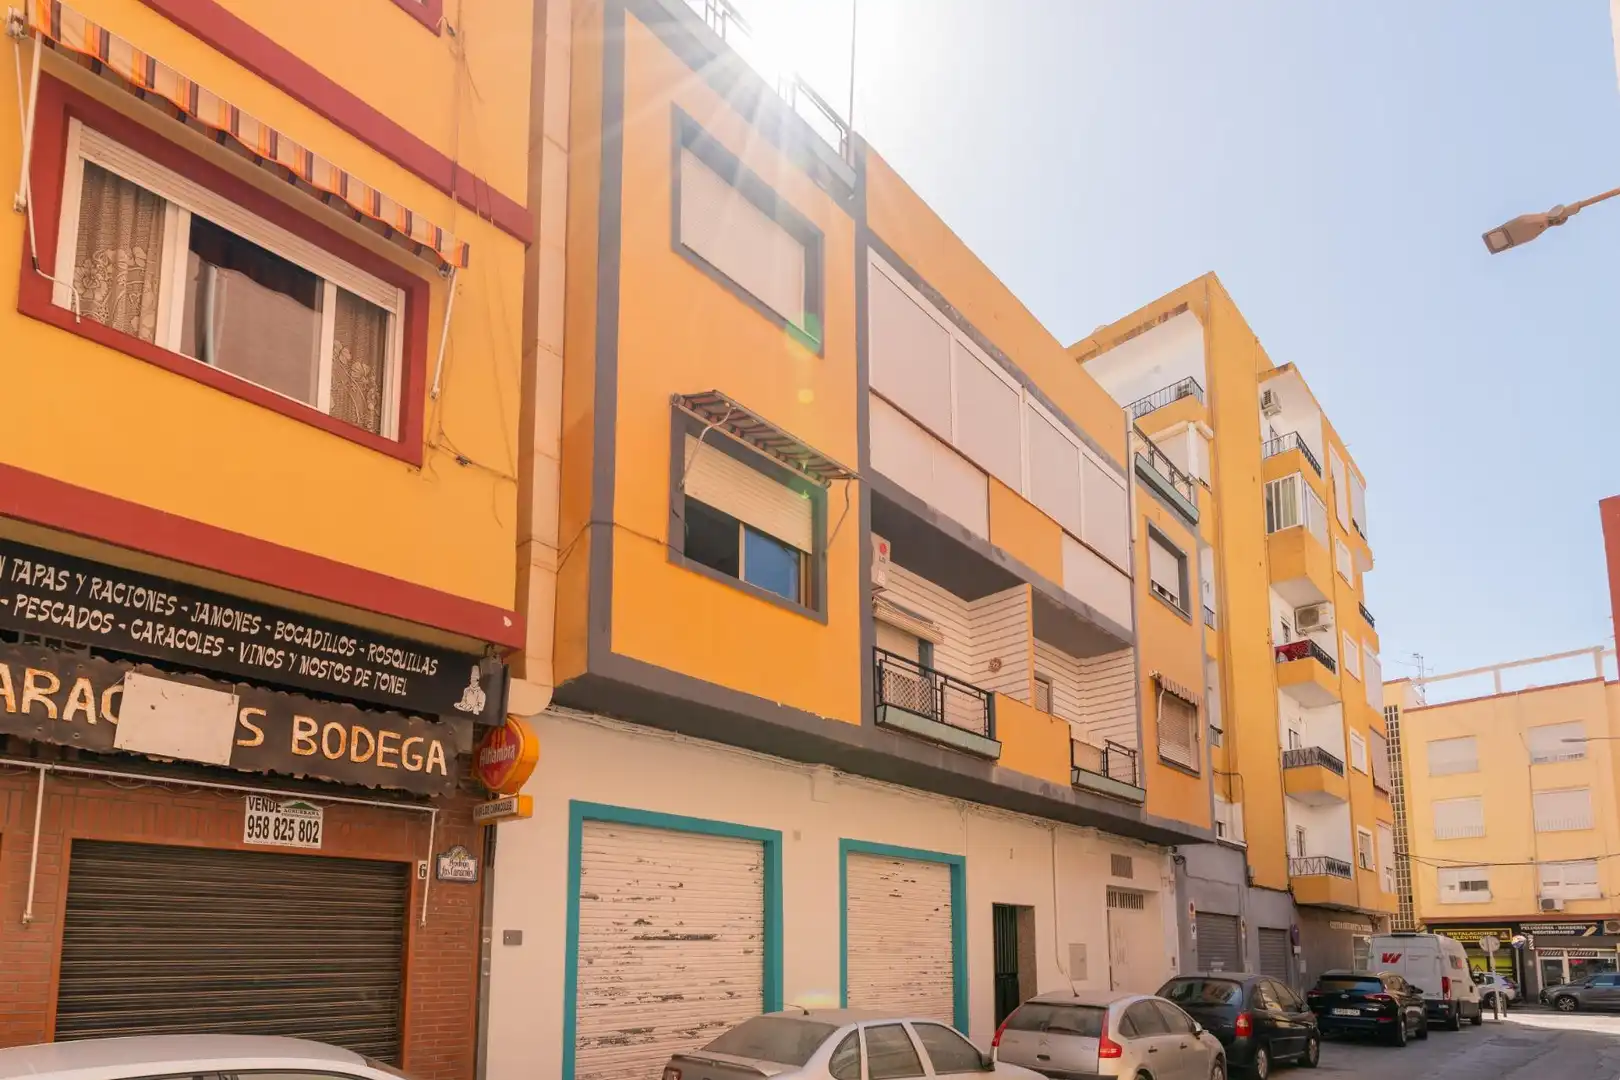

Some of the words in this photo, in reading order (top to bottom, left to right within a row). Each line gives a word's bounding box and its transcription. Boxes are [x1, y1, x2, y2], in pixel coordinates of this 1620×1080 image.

[11, 558, 71, 591] TAPAS
[76, 573, 87, 593] Y
[89, 577, 177, 616] RACIONES
[191, 602, 262, 635] JAMONES
[274, 620, 357, 657] BOCADILLOS
[367, 642, 439, 676] ROSQUILLAS
[13, 594, 115, 634] PESCADOS
[130, 618, 225, 657] CARACOLES
[238, 641, 285, 669] VINOS
[288, 652, 298, 672] Y
[298, 656, 352, 684] MOSTOS
[353, 670, 372, 688] DE
[373, 672, 407, 697] TONEL
[291, 714, 448, 777] BODEGA
[248, 796, 282, 813] VENDE
[247, 814, 270, 839] 958
[273, 816, 295, 842] 825
[298, 819, 320, 843] 802
[419, 863, 427, 878] 6
